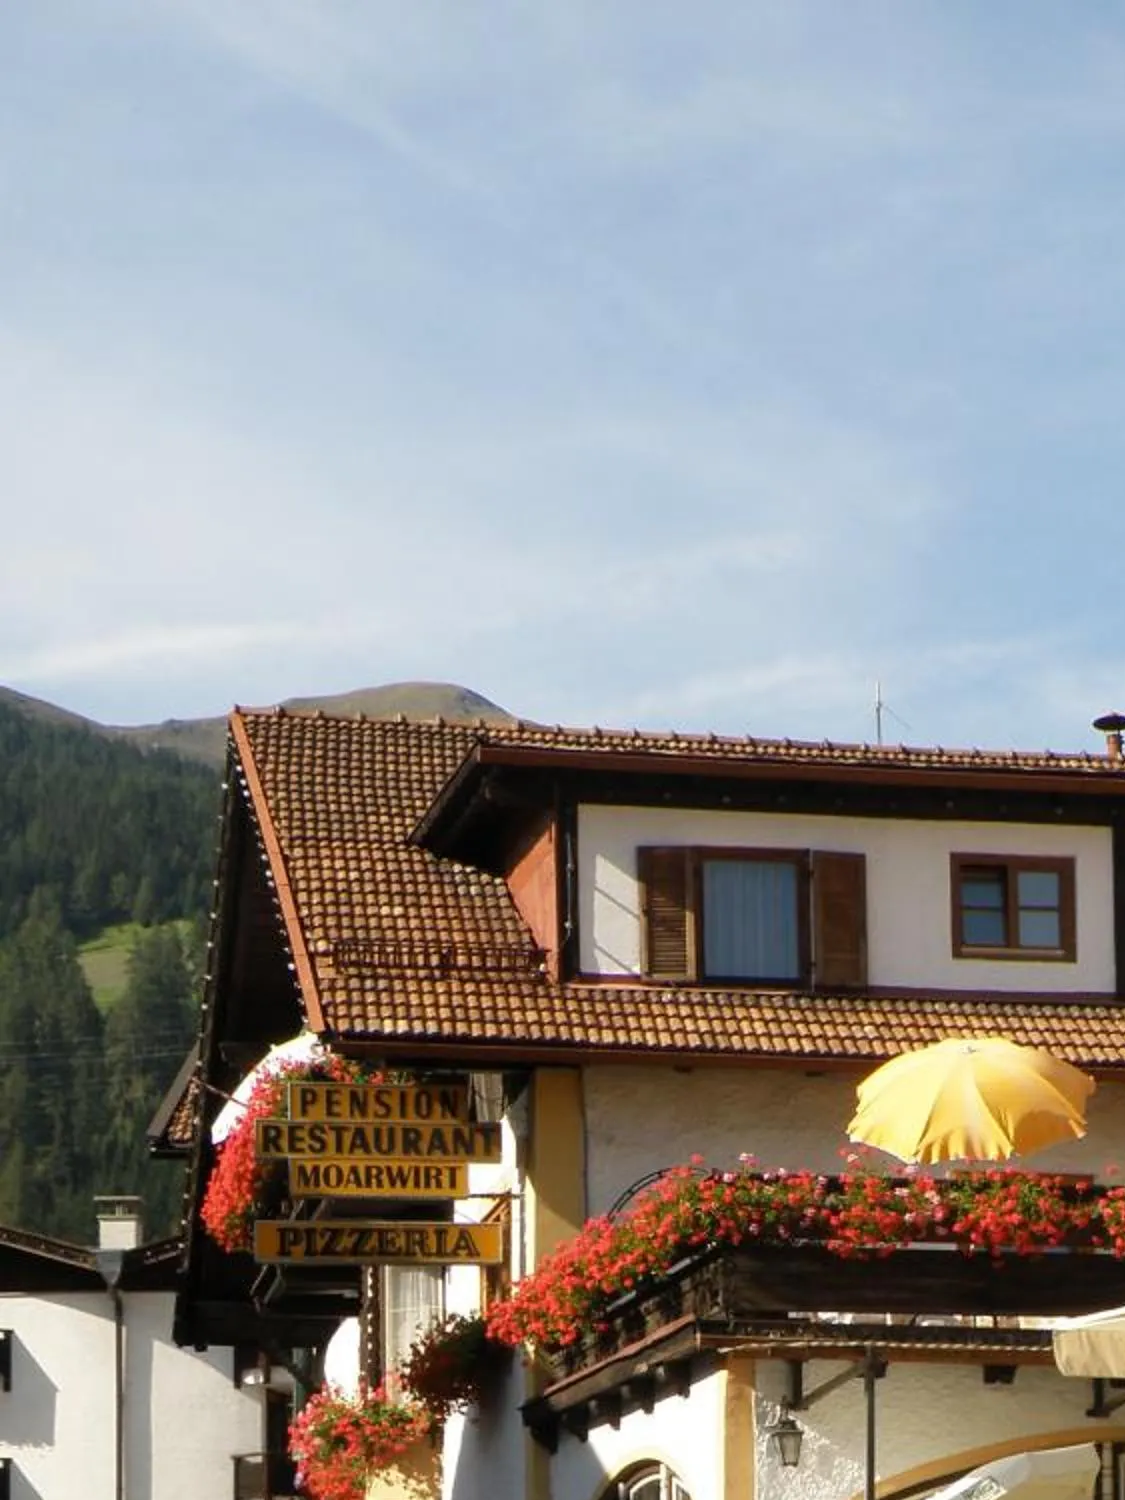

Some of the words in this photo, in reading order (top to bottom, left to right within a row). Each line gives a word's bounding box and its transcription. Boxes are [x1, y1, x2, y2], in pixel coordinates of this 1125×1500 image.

[300, 1087, 459, 1120] PENSION
[261, 1124, 496, 1156] RESTAURANT
[299, 1164, 463, 1190] MOARWIRT
[276, 1227, 481, 1257] PIZZERIA
